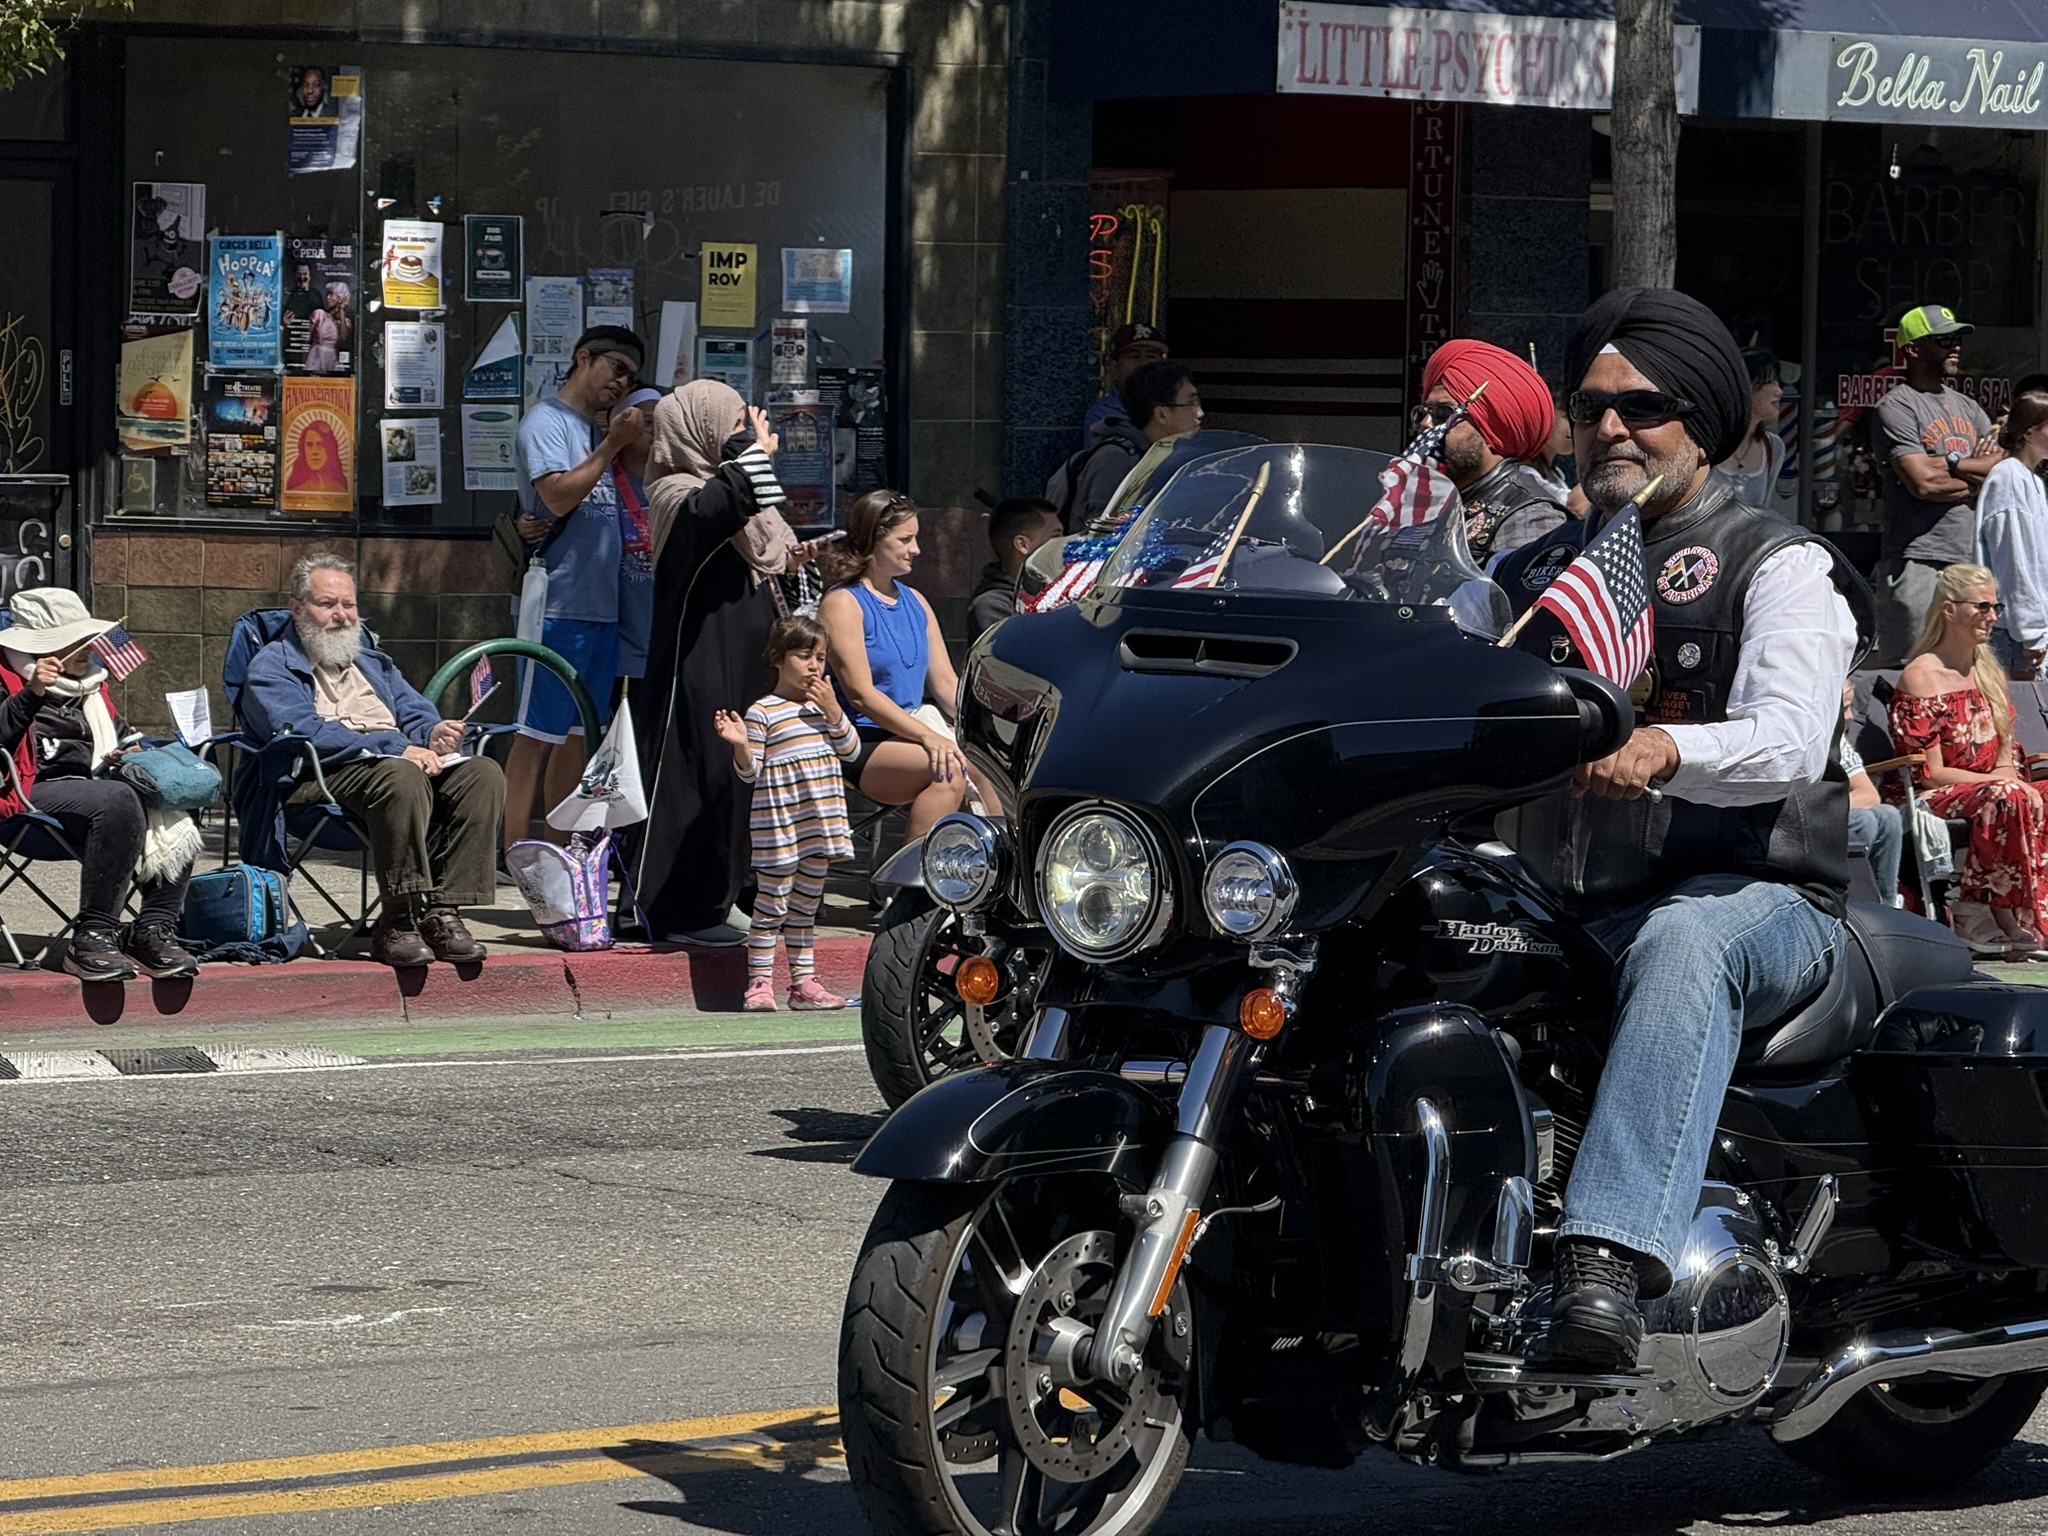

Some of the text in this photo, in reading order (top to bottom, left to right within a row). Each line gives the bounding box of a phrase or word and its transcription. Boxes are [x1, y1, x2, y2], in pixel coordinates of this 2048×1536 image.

[1296, 20, 1421, 90] LITTLE
[1836, 41, 2045, 115] Bella Nail
[1824, 181, 2026, 248] BARBER
[218, 240, 273, 250] CIRCUS BELLA
[292, 248, 327, 259] OPERA
[709, 251, 748, 269] IMP
[708, 273, 741, 286] ROV
[1855, 256, 1994, 322] SHOP
[62, 353, 71, 394] PULL
[1978, 377, 2013, 409] SPA
[1922, 416, 1951, 449] NEW
[1690, 545, 1719, 575] RIDERS
[1662, 580, 1714, 602] AMERICA
[1433, 919, 1520, 943] Harley
[1468, 937, 1564, 956] Davidson
